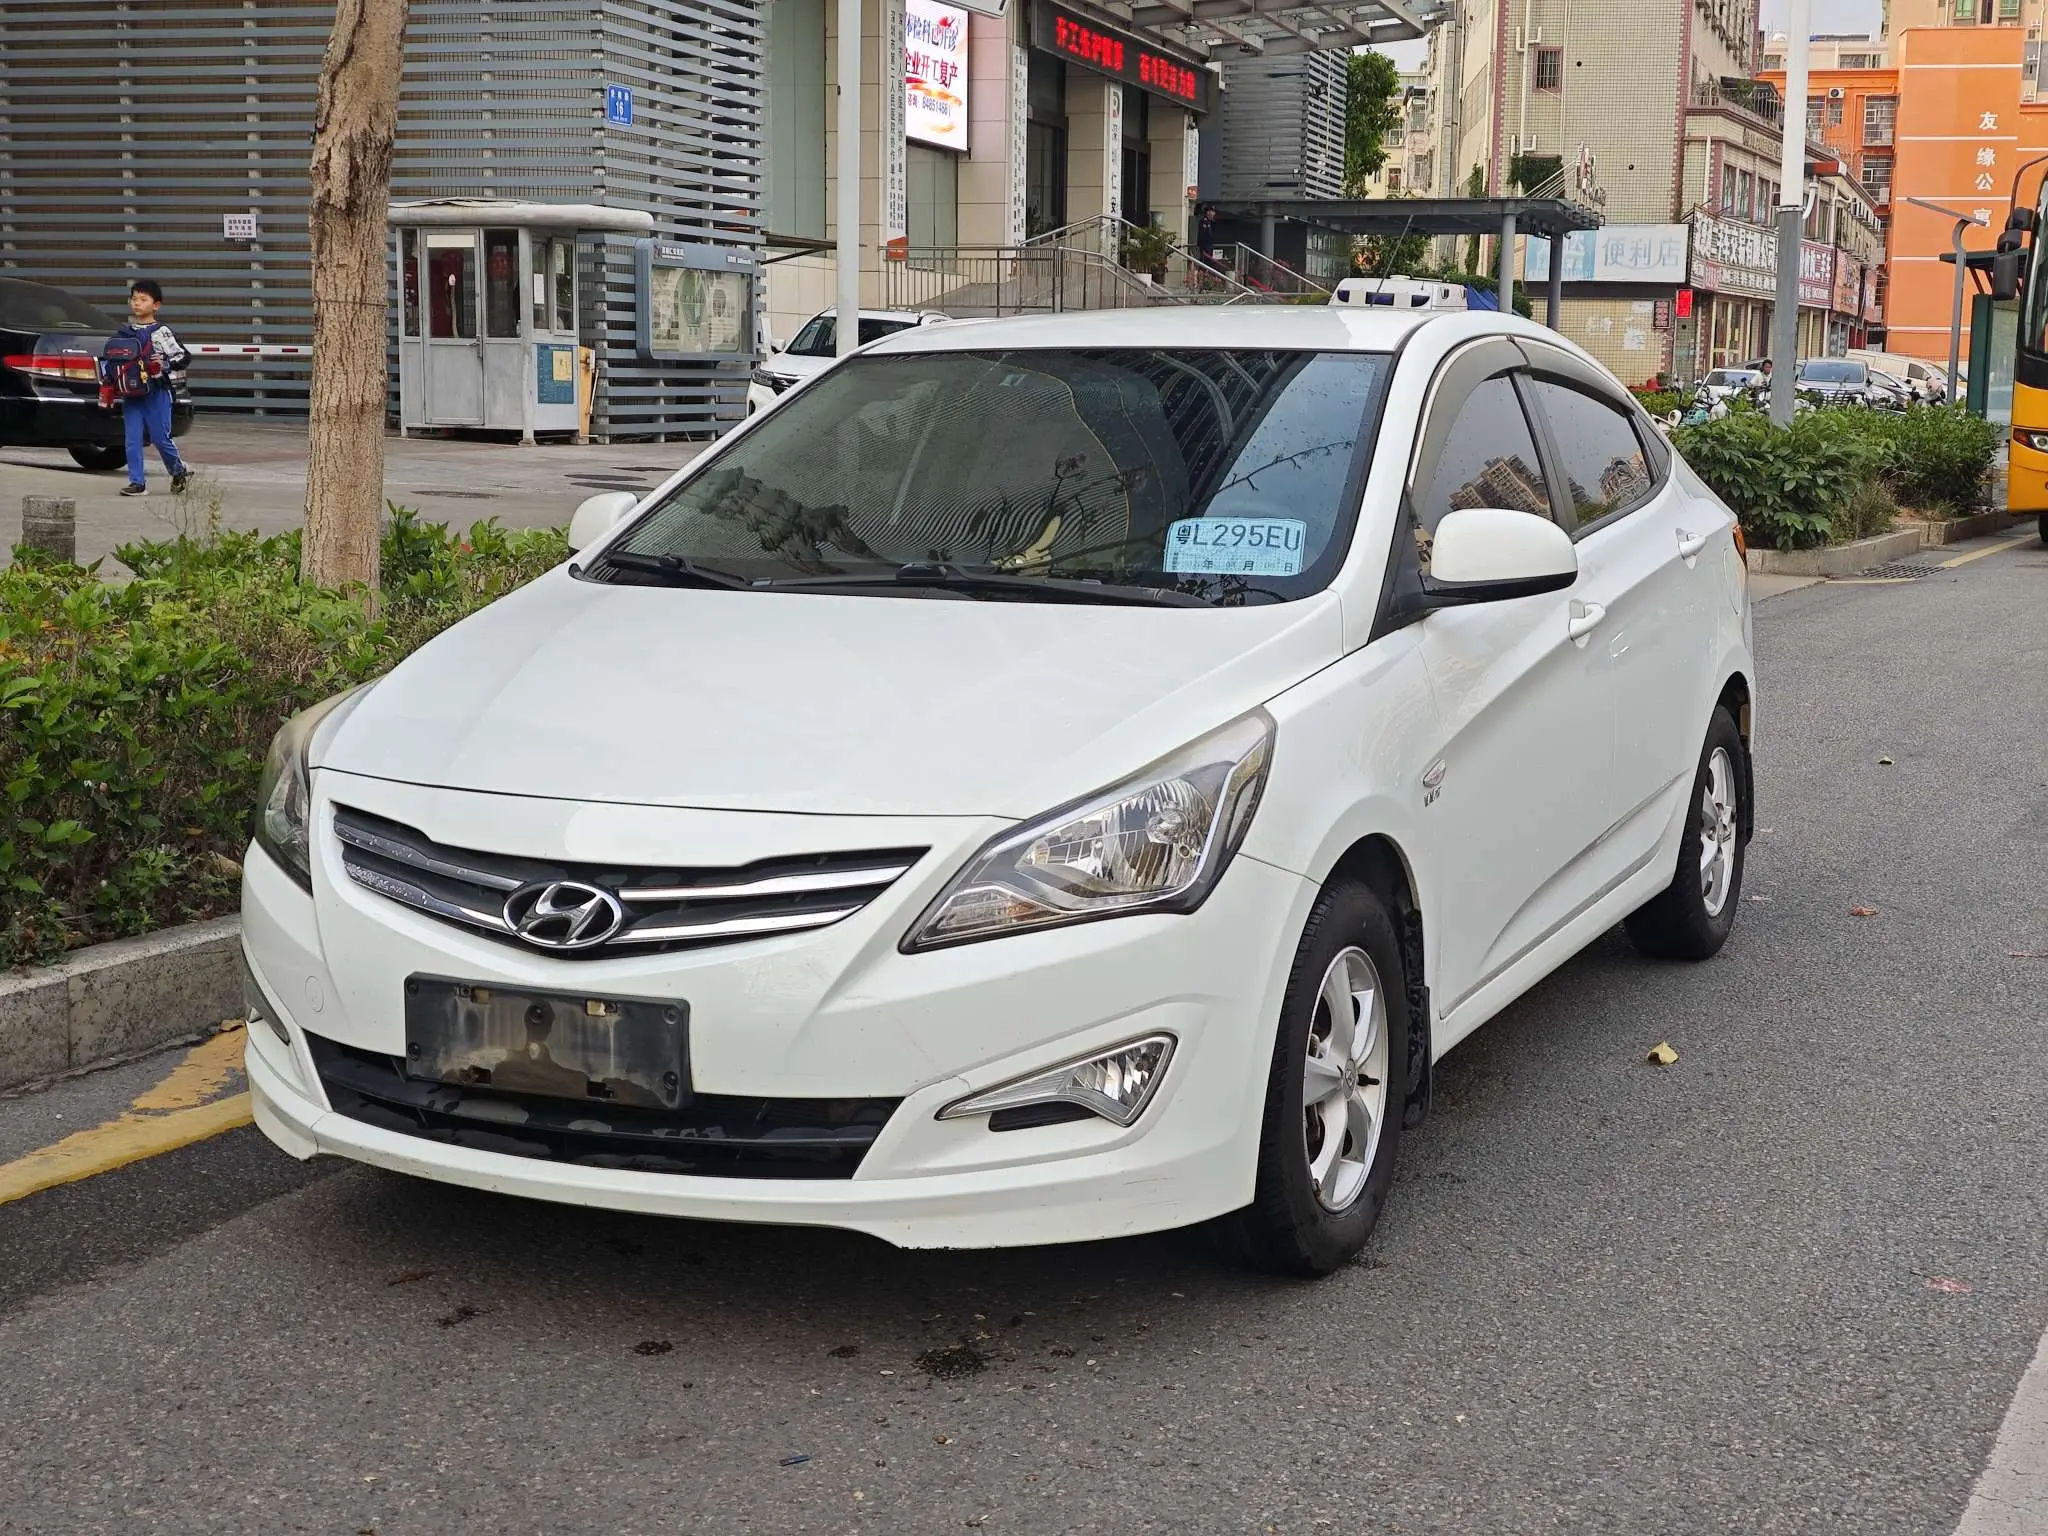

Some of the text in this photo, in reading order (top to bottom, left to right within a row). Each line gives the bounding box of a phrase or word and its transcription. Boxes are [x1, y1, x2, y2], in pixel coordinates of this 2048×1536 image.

[615, 100, 624, 116] 16
[1974, 111, 1999, 228] 友缘公寓
[1603, 235, 1681, 268] 便利店
[1175, 522, 1301, 551] 粤L295EU
[1243, 560, 1254, 571] 月
[1284, 562, 1293, 573] 日
